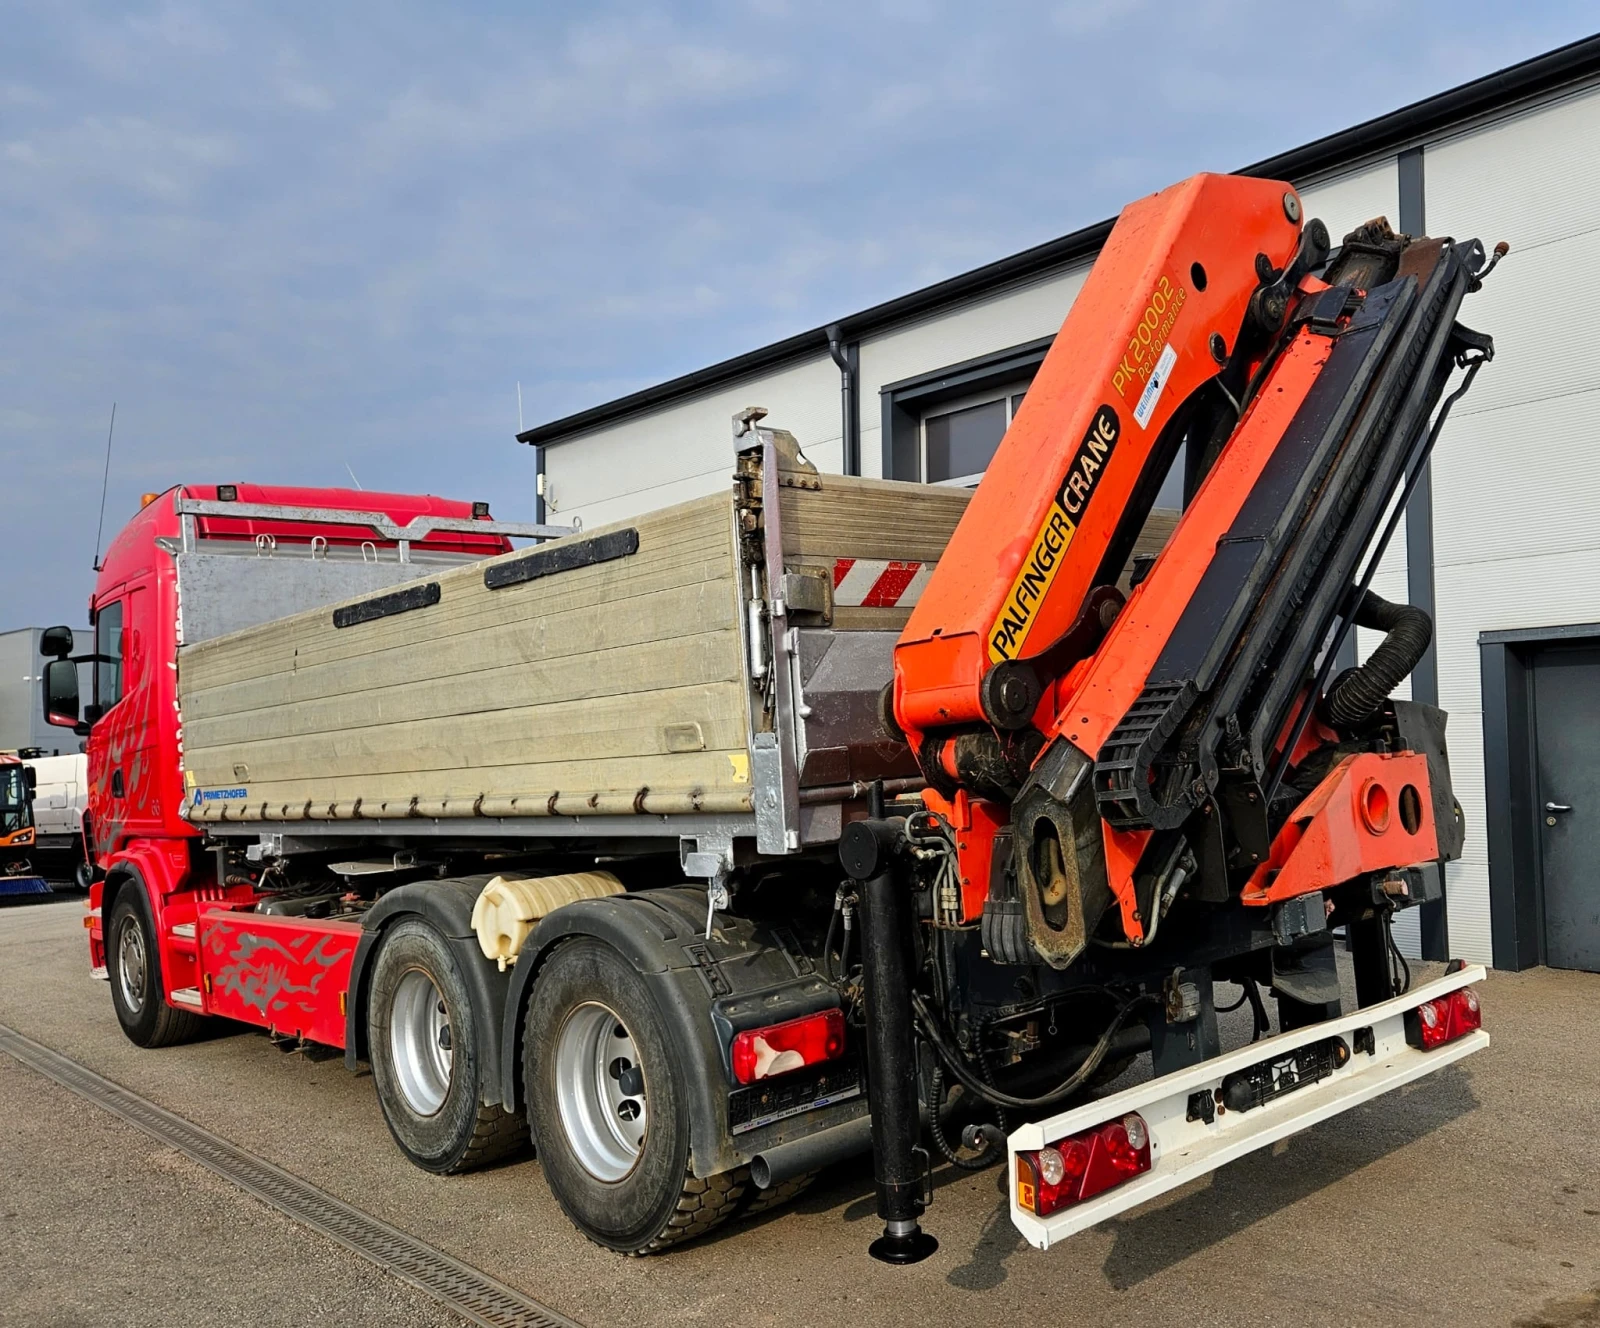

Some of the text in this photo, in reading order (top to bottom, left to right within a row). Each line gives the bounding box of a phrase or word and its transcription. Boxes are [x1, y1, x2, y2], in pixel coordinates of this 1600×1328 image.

[1112, 354, 1137, 397] PK
[1128, 275, 1174, 363] 20002
[1137, 287, 1187, 384] Performance
[991, 414, 1117, 660] PALFINGER CRANE
[202, 788, 248, 801] PRIMETZHOFER
